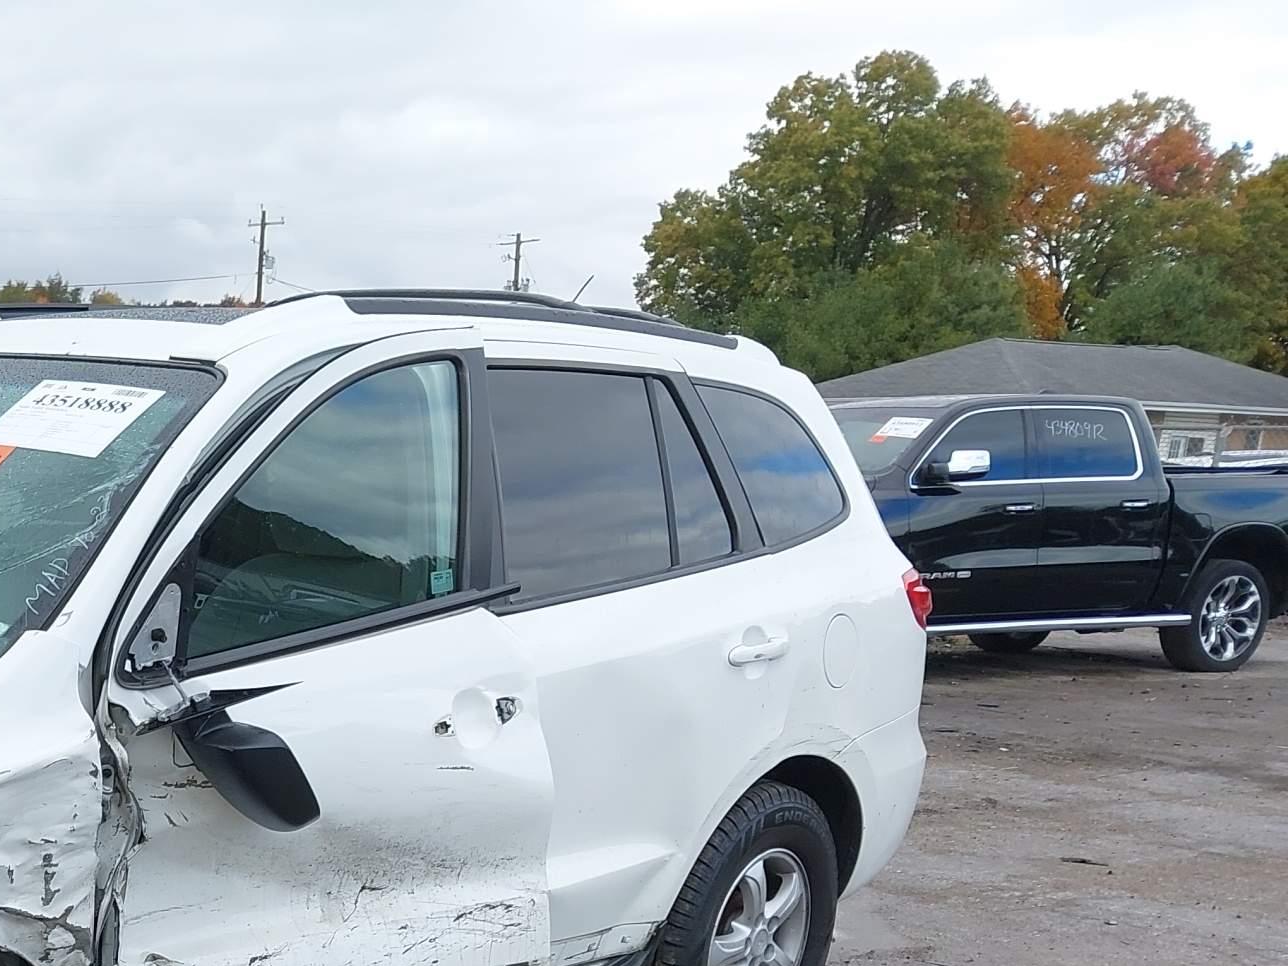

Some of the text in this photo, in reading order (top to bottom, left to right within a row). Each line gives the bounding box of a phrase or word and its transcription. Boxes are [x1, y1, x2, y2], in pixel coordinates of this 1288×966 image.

[32, 392, 133, 414] 43518888
[25, 557, 70, 615] MAD
[919, 571, 955, 580] RAM
